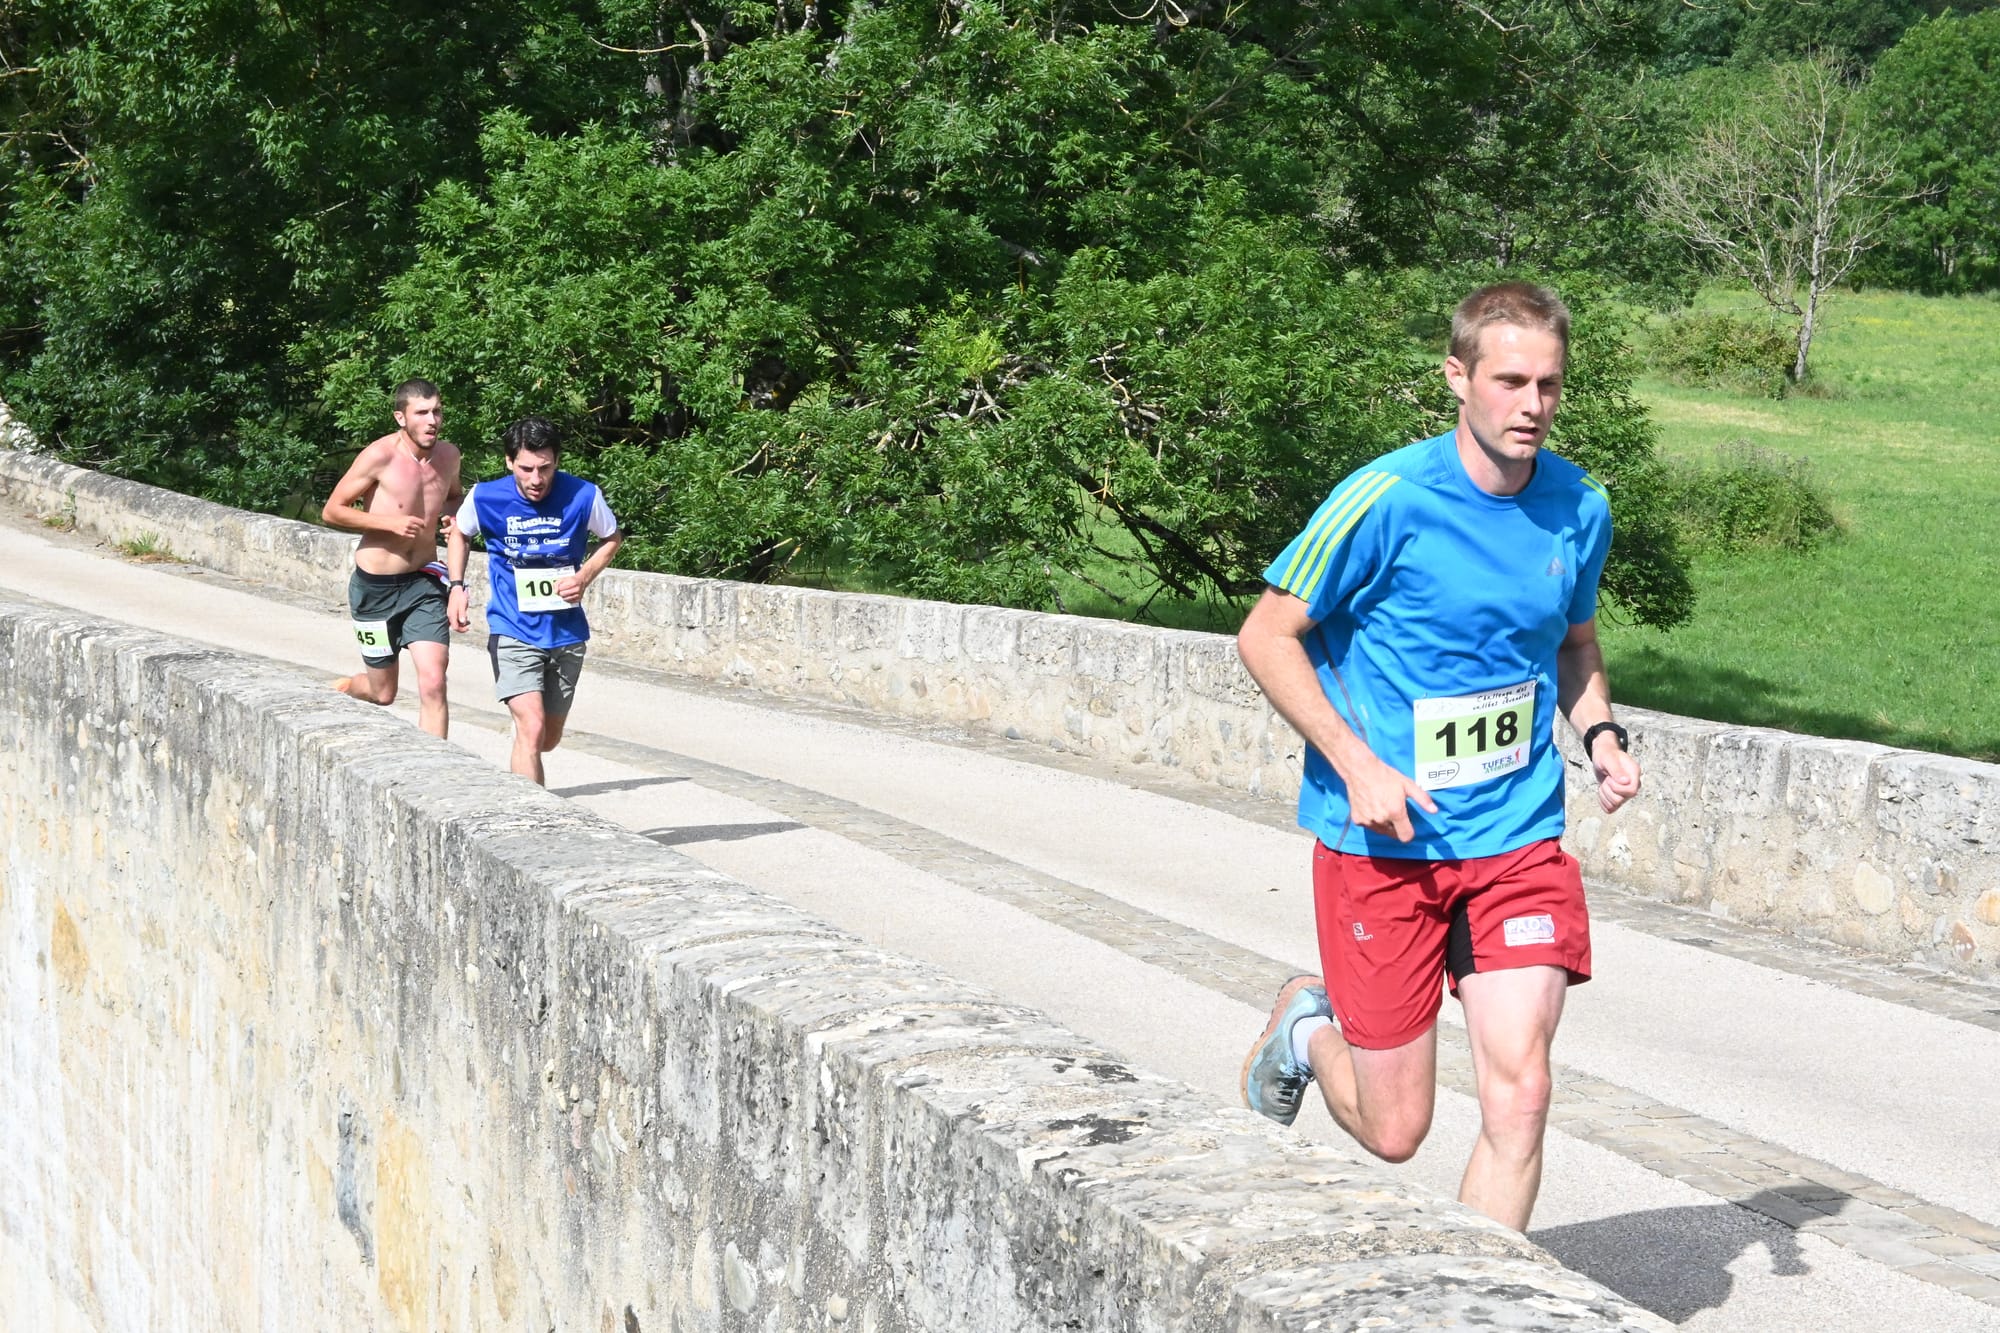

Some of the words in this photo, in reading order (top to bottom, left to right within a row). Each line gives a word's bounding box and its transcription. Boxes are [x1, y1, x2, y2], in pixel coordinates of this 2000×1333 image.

[525, 579, 557, 597] 10
[1436, 711, 1518, 757] 118
[1428, 768, 1456, 779] BFP
